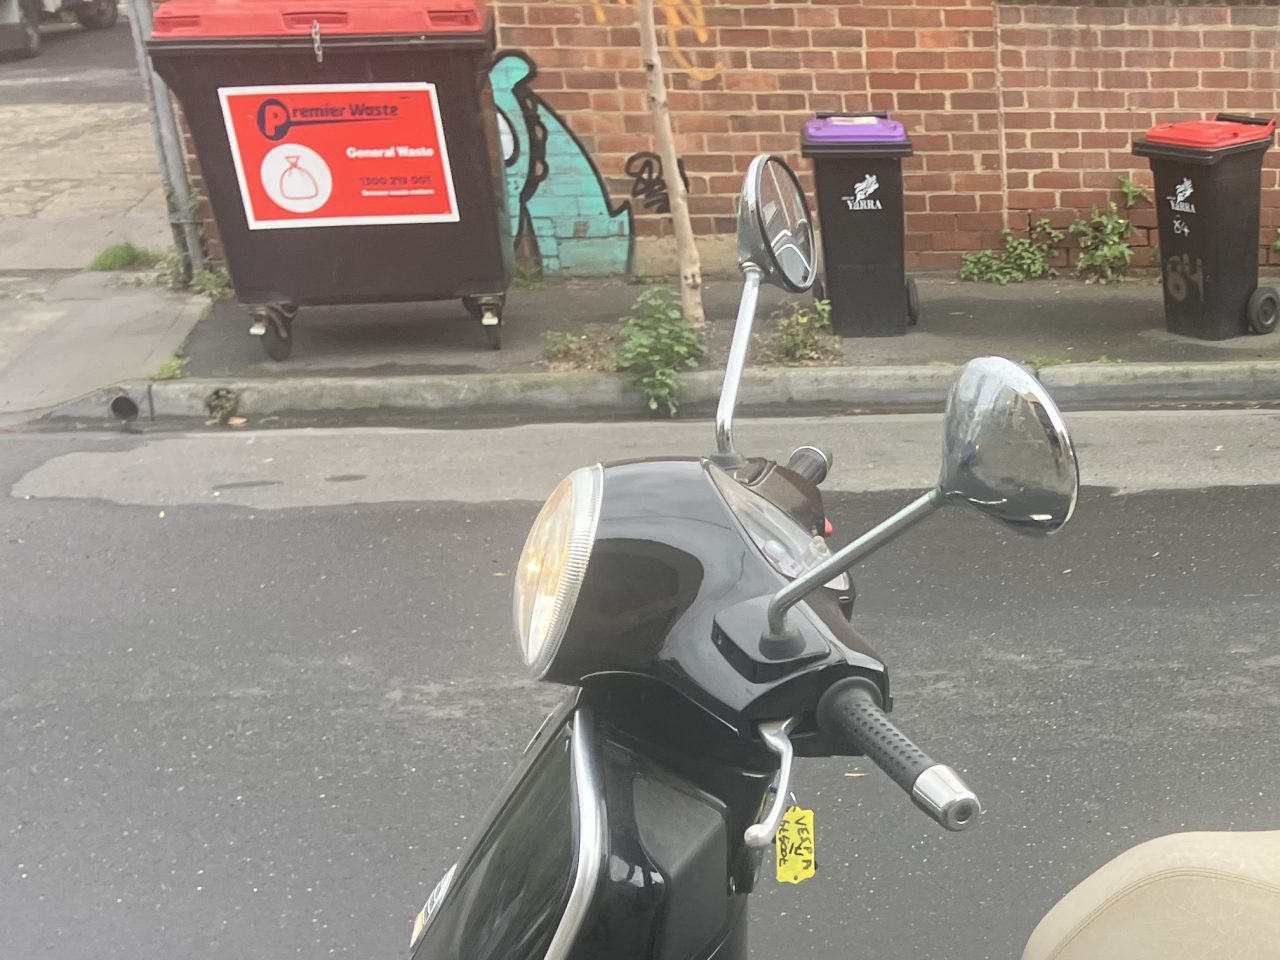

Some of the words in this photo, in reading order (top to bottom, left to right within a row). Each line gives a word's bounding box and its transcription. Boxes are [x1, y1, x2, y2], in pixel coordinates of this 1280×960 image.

[257, 98, 346, 141] Premier
[350, 103, 398, 117] Waste
[345, 146, 395, 158] General
[396, 145, 435, 157] Waste
